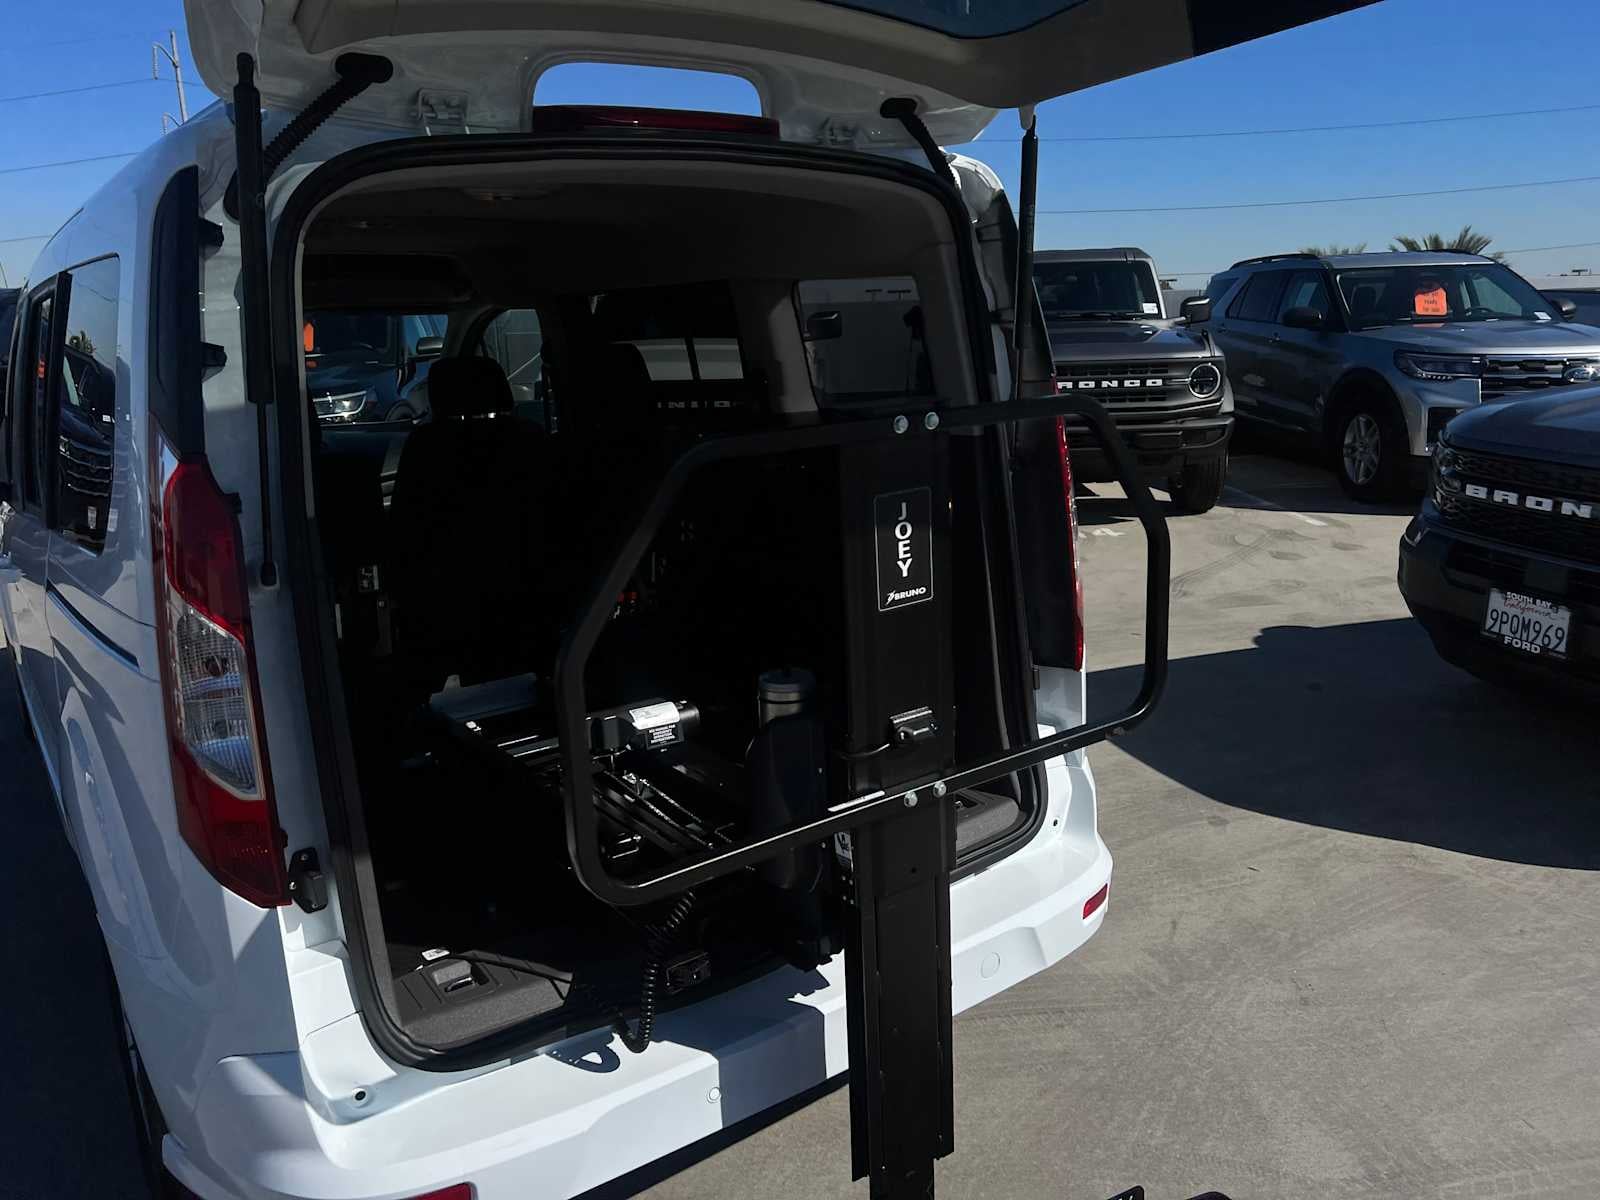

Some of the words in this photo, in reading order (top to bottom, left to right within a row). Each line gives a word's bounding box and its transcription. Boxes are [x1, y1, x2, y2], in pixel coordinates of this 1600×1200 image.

[1057, 379, 1163, 389] RONCO
[1465, 483, 1593, 519] BRON
[894, 501, 913, 578] JOEY
[894, 586, 927, 601] BRUNO
[1506, 591, 1533, 604] SOUTH
[1535, 598, 1552, 609] BAY
[1503, 635, 1541, 654] FORD
